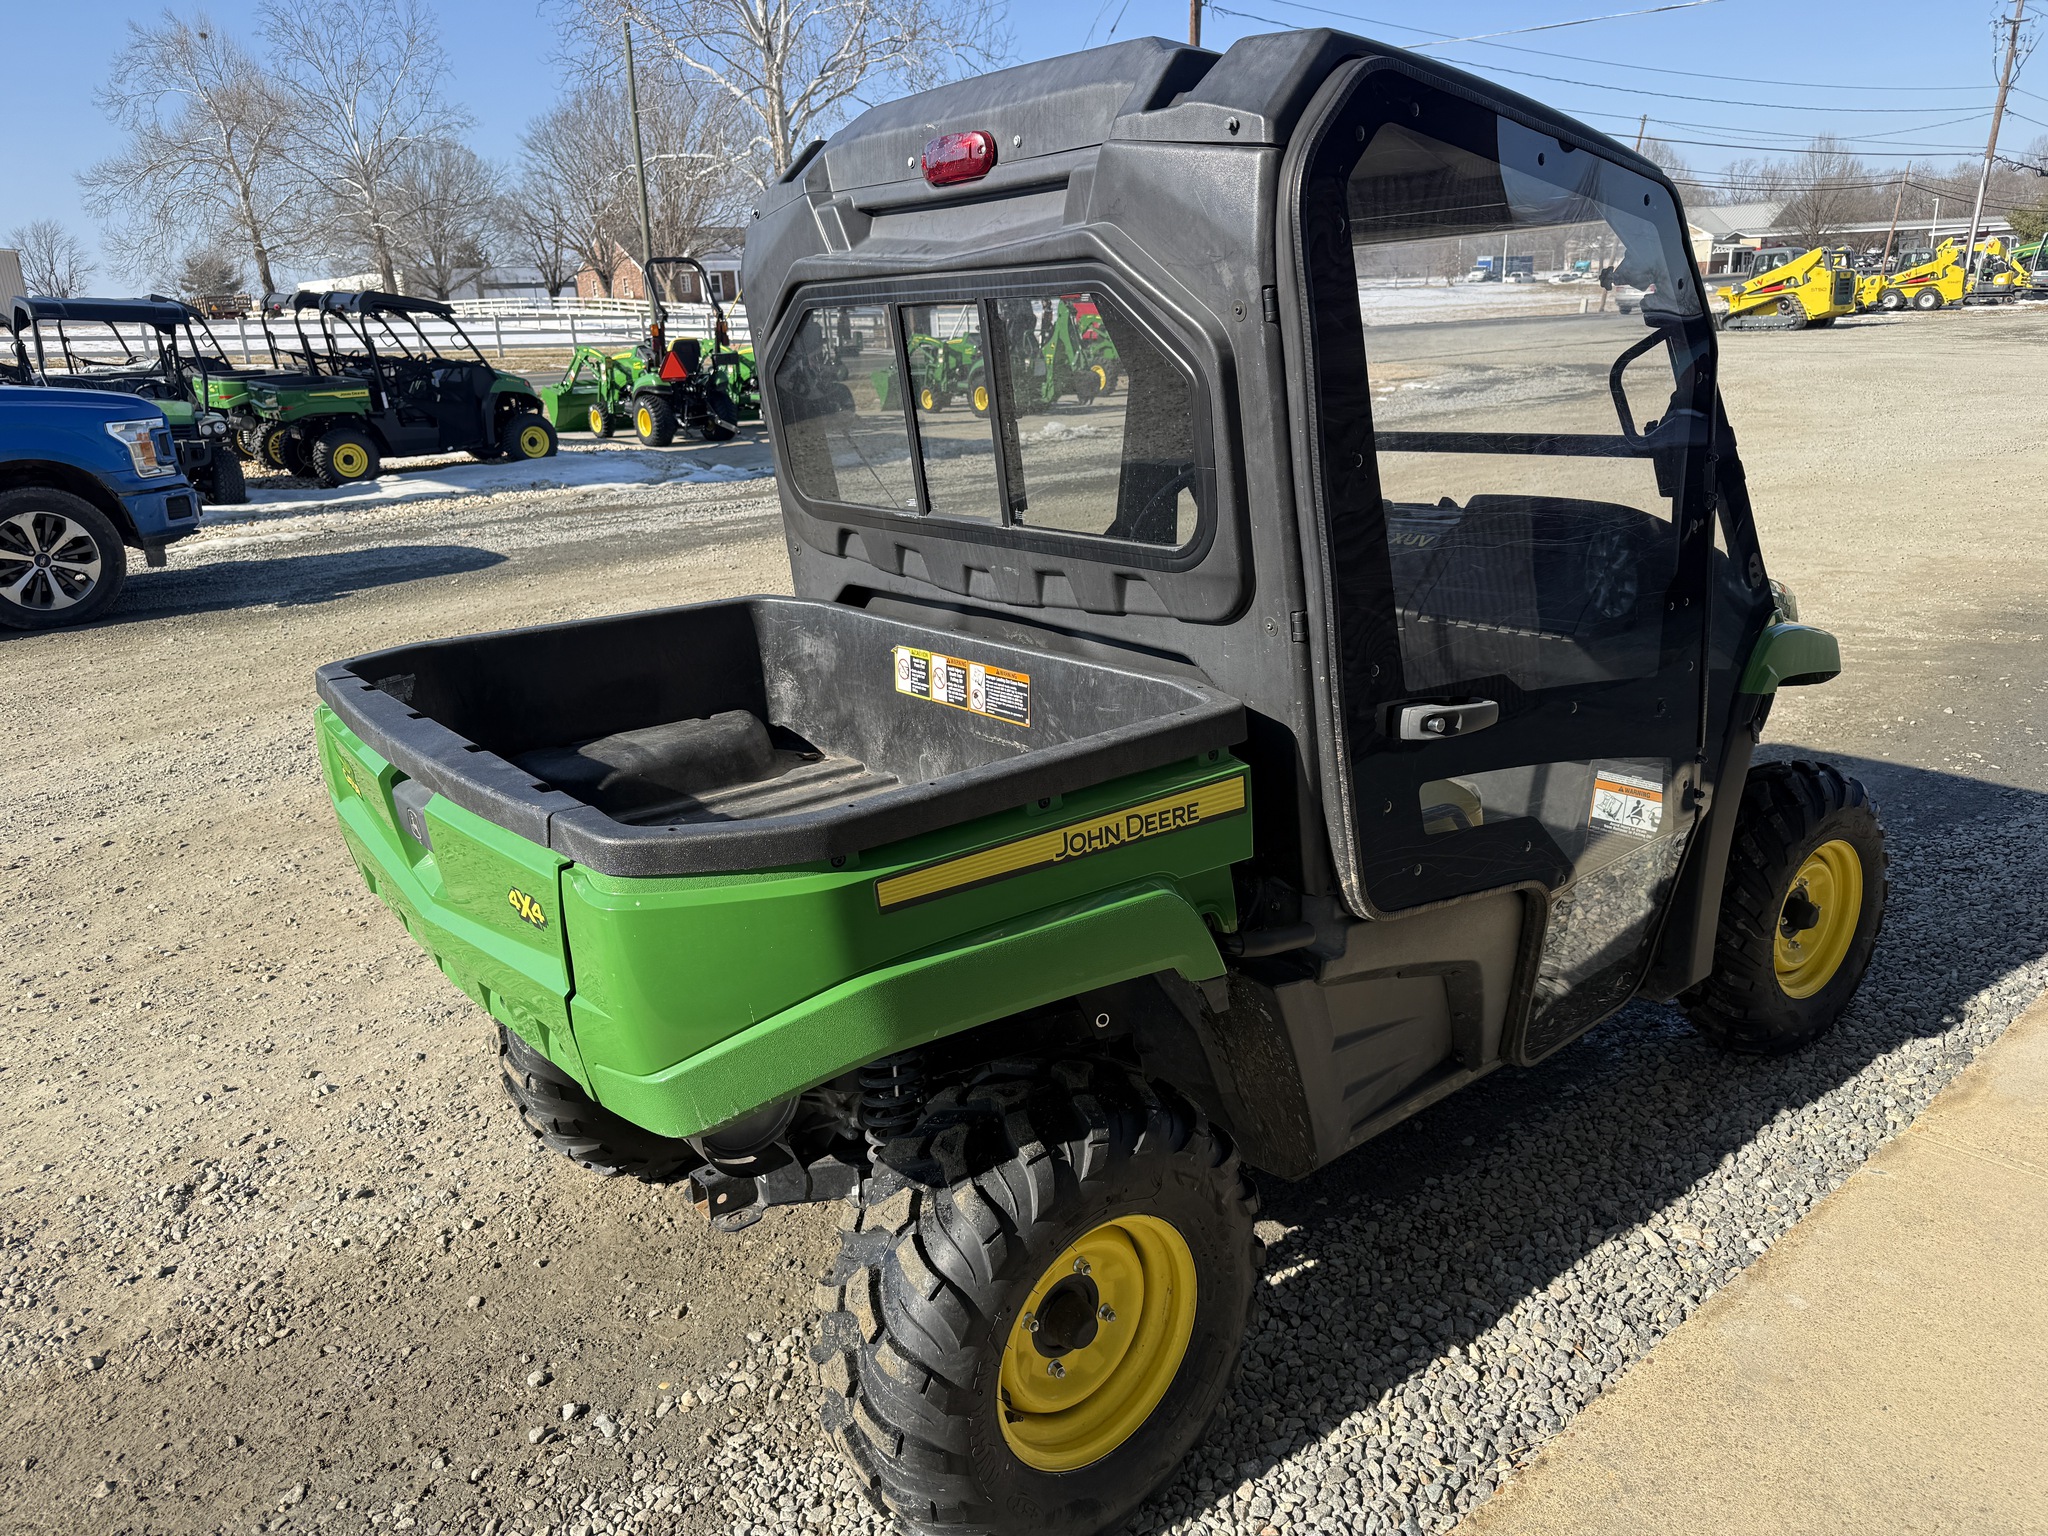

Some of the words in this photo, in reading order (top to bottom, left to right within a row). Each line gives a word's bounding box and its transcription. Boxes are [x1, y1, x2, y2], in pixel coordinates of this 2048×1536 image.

[1388, 533, 1436, 547] XUV
[1625, 788, 1651, 798] WARNING
[1055, 823, 1121, 858] JOHN
[1126, 802, 1200, 838] DEERE
[508, 888, 546, 925] 4X4
